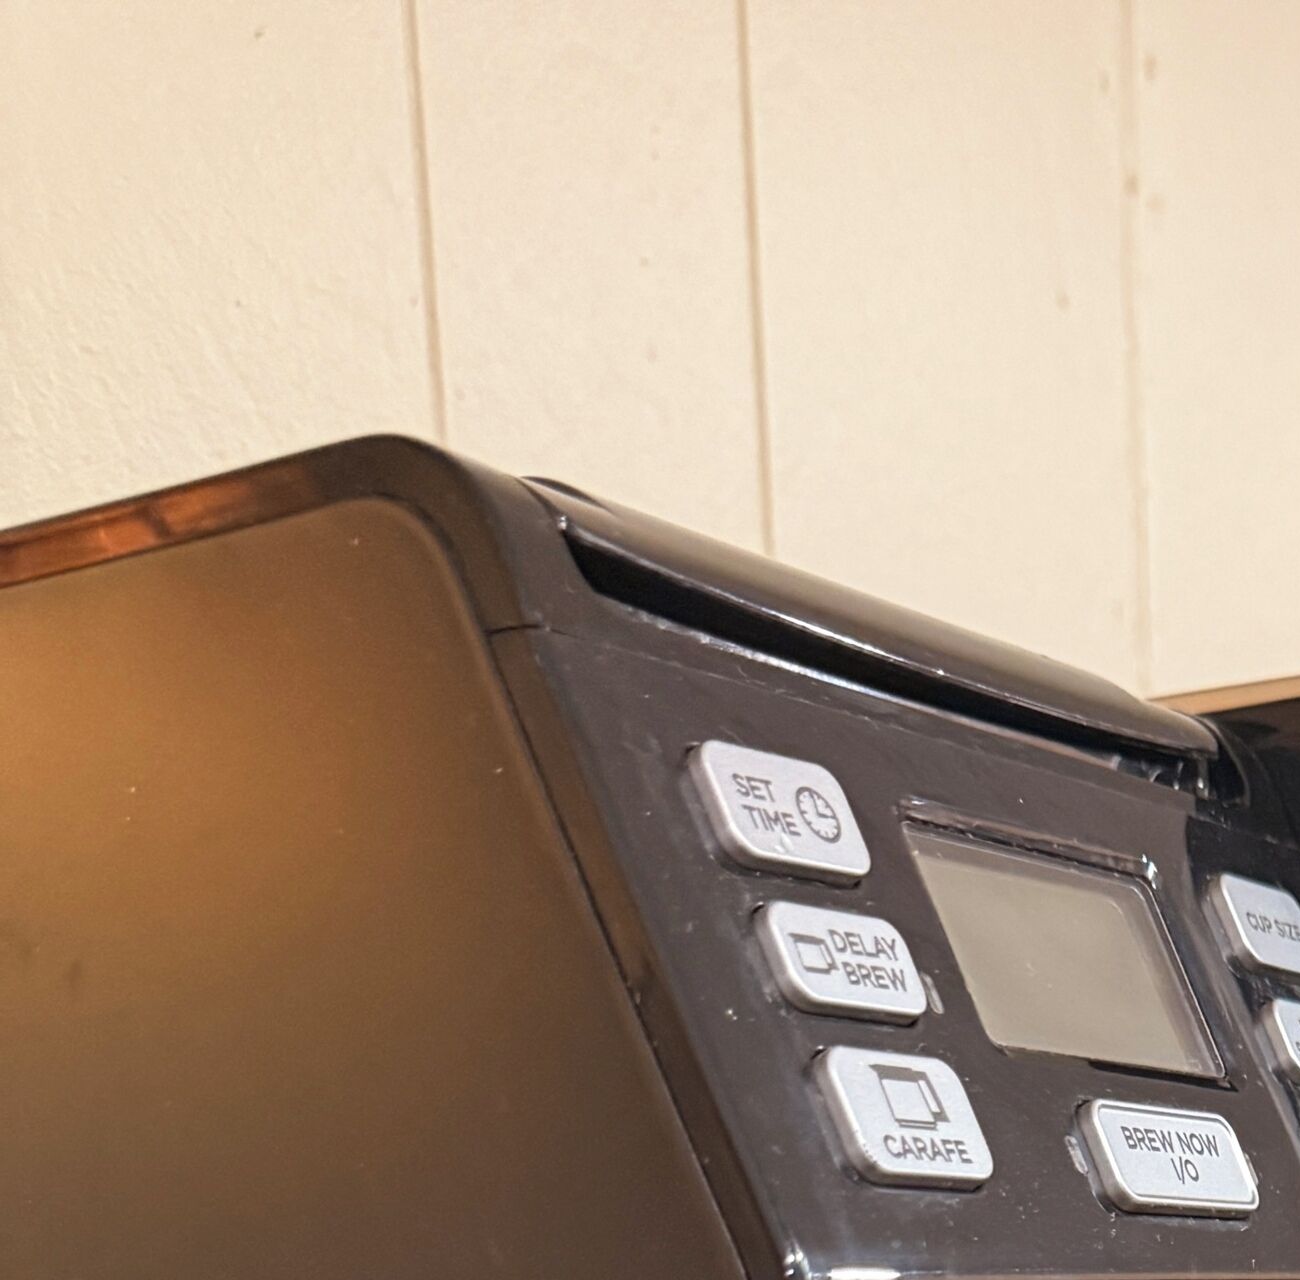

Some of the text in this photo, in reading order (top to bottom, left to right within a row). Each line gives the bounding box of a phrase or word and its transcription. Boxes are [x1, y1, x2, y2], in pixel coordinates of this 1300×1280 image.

[731, 773, 775, 802] SET
[741, 804, 801, 836] TIME
[1246, 911, 1272, 936] CUP
[832, 929, 898, 962] DELAY
[846, 964, 908, 993] BREW
[882, 1134, 973, 1165] CARAFE
[1120, 1125, 1220, 1158] BREW NOW
[1171, 1156, 1200, 1184] I/O
